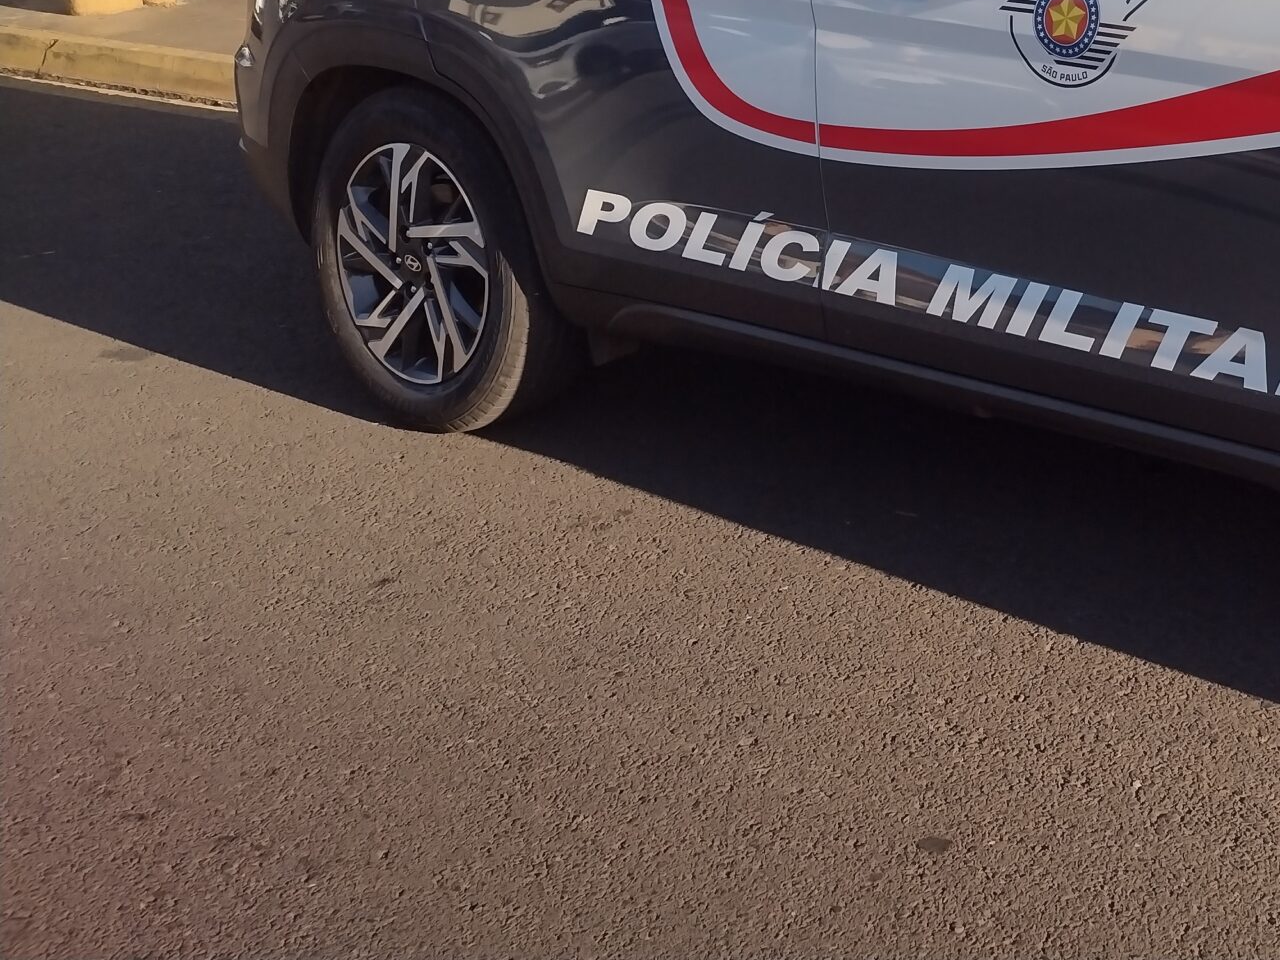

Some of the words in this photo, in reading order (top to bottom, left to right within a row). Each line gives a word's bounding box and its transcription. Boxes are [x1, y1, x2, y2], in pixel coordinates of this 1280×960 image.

[1041, 64, 1058, 79] SÃO
[1059, 70, 1089, 82] PAULO
[576, 188, 899, 306] POLÍCIA
